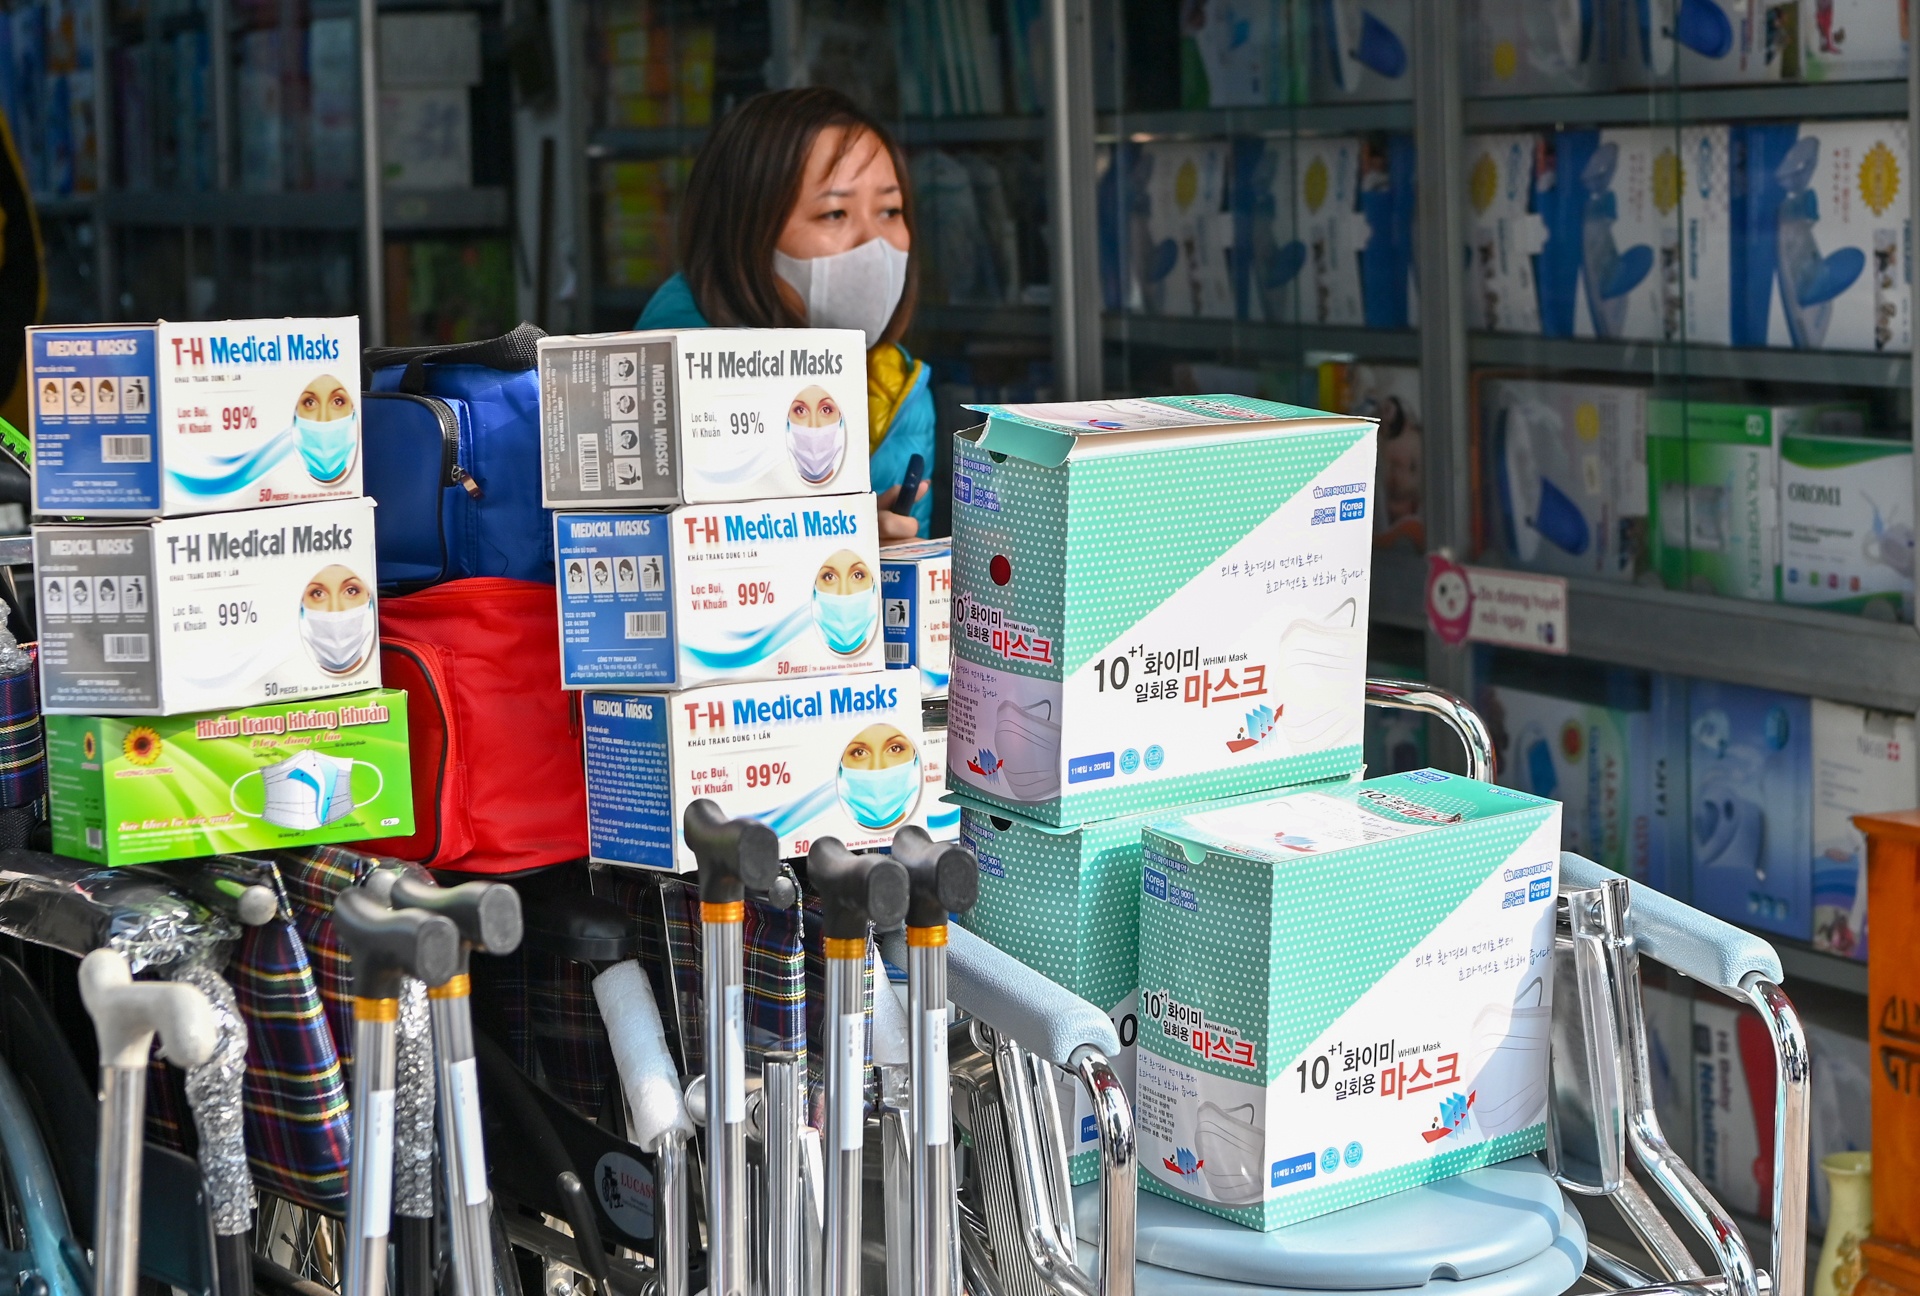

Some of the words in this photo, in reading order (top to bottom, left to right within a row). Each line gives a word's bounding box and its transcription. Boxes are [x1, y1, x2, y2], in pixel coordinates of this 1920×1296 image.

[46, 340, 94, 356] MEDICAL
[96, 339, 137, 356] MASKS
[172, 338, 204, 366] T-H
[210, 335, 281, 364] Medical
[287, 334, 339, 361] Masks
[686, 352, 712, 380] T-H
[718, 350, 784, 378] Medical
[790, 349, 842, 376] Masks
[652, 364, 666, 424] MEDICAL
[222, 406, 257, 430] 99%
[730, 412, 764, 435] 99%
[654, 428, 669, 476] MASKS
[259, 488, 272, 502] 50
[975, 488, 984, 497] ISO
[985, 490, 997, 499] 9001
[984, 501, 999, 511] 14001
[1342, 502, 1363, 511] Korea
[571, 522, 613, 538] MEDICAL
[616, 520, 650, 536] MASKS
[684, 516, 719, 544] T-H
[724, 512, 798, 542] Medical
[802, 510, 857, 537] Masks
[50, 540, 95, 556] MEDICAL
[96, 538, 134, 554] MASKS
[167, 535, 200, 564] T-H
[208, 528, 285, 561] Medical
[293, 524, 352, 554] Masks
[706, 552, 724, 561] TRANG
[738, 581, 774, 606] 99%
[218, 601, 258, 626] 99%
[971, 604, 1001, 628] 화이미
[1004, 622, 1019, 630] WHIMI
[1021, 626, 1035, 634] Mask
[966, 623, 989, 642] 일회용
[993, 630, 1052, 663] 마스크
[778, 661, 789, 675] 50
[790, 665, 808, 673] PIECES
[1144, 646, 1199, 676] 화이미
[1203, 657, 1227, 666] WHIMI
[1229, 652, 1248, 662] Mask
[265, 682, 278, 696] 50
[280, 686, 298, 694] PIECES
[1135, 679, 1179, 703] 일회용
[1184, 664, 1268, 708] 마스크
[241, 716, 285, 735] trang
[287, 710, 337, 731] kháng
[339, 701, 389, 726] khuẩn
[593, 700, 624, 717] MEDICAL
[625, 703, 653, 720] MASKS
[684, 701, 725, 730] T-H
[733, 691, 822, 725] Medical
[830, 684, 897, 714] Masks
[709, 736, 730, 746] TRANG
[691, 770, 708, 781] Lọc
[746, 762, 791, 788] 99%
[692, 786, 702, 795] Vi
[795, 840, 809, 854] 50
[1146, 870, 1164, 887] Korea
[1531, 881, 1550, 892] Korea
[1170, 887, 1179, 896] ISO
[1181, 890, 1194, 900] 9001
[1170, 896, 1179, 905] ISO
[1181, 900, 1197, 910] 14001
[1168, 1002, 1201, 1029] 화이미
[1204, 1022, 1221, 1032] WHIMI
[1223, 1027, 1238, 1036] Mask
[1163, 1020, 1189, 1041] 일회용
[1193, 1030, 1254, 1067] 마스크
[1343, 1039, 1395, 1072] 화이미
[1398, 1048, 1421, 1058] WHIMI
[1422, 1042, 1441, 1052] Mask
[1334, 1074, 1375, 1101] 일회용
[1380, 1052, 1460, 1101] 마스크
